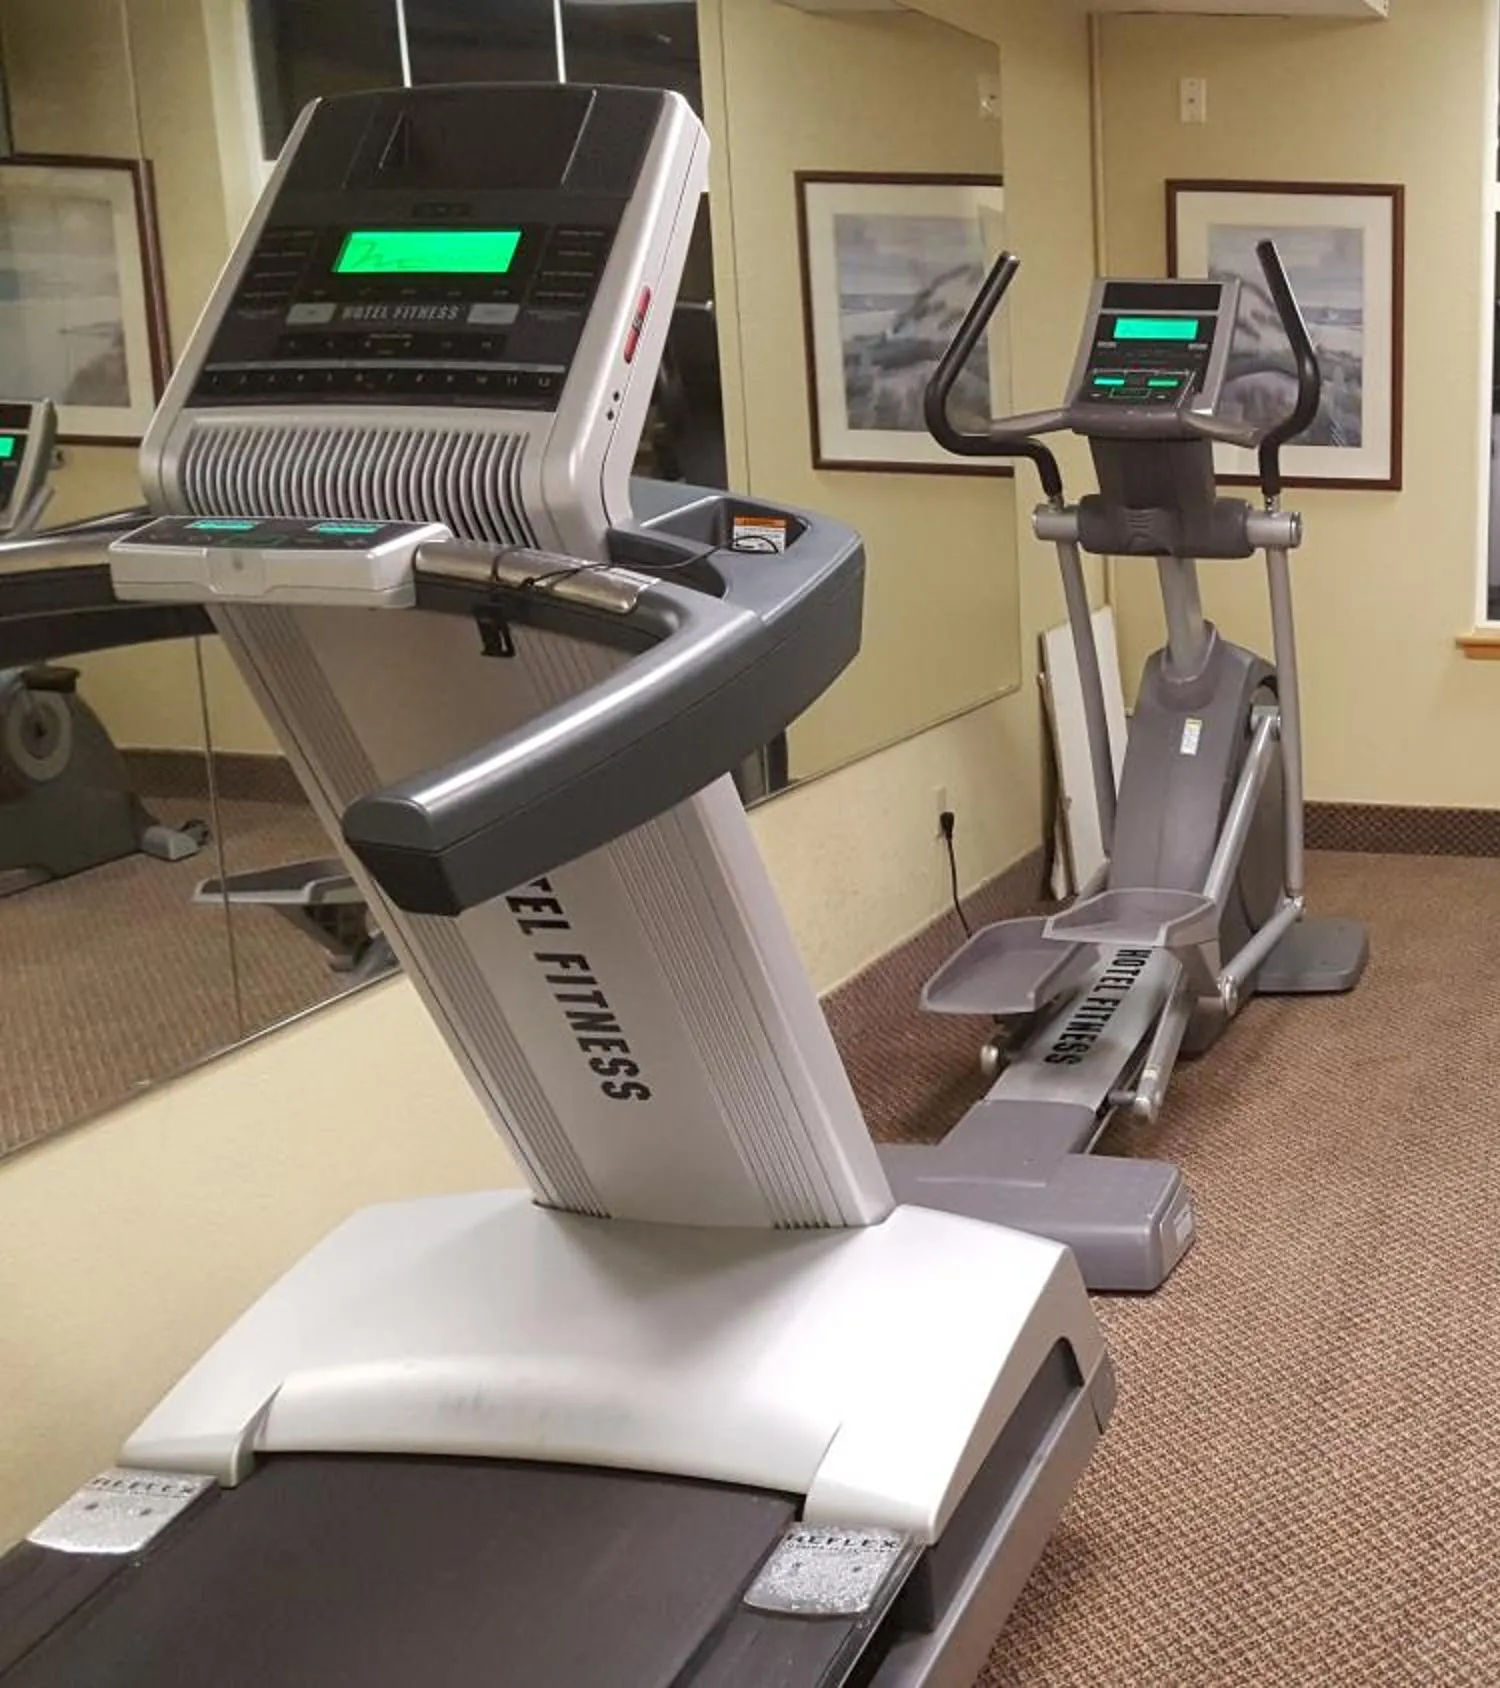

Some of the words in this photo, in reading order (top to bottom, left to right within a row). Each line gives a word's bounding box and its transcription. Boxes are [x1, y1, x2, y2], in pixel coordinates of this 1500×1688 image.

[393, 304, 459, 321] FITNESS
[1092, 949, 1152, 992] HOTEL
[534, 952, 653, 1101] FITNESS
[1043, 997, 1121, 1065] FITNESS
